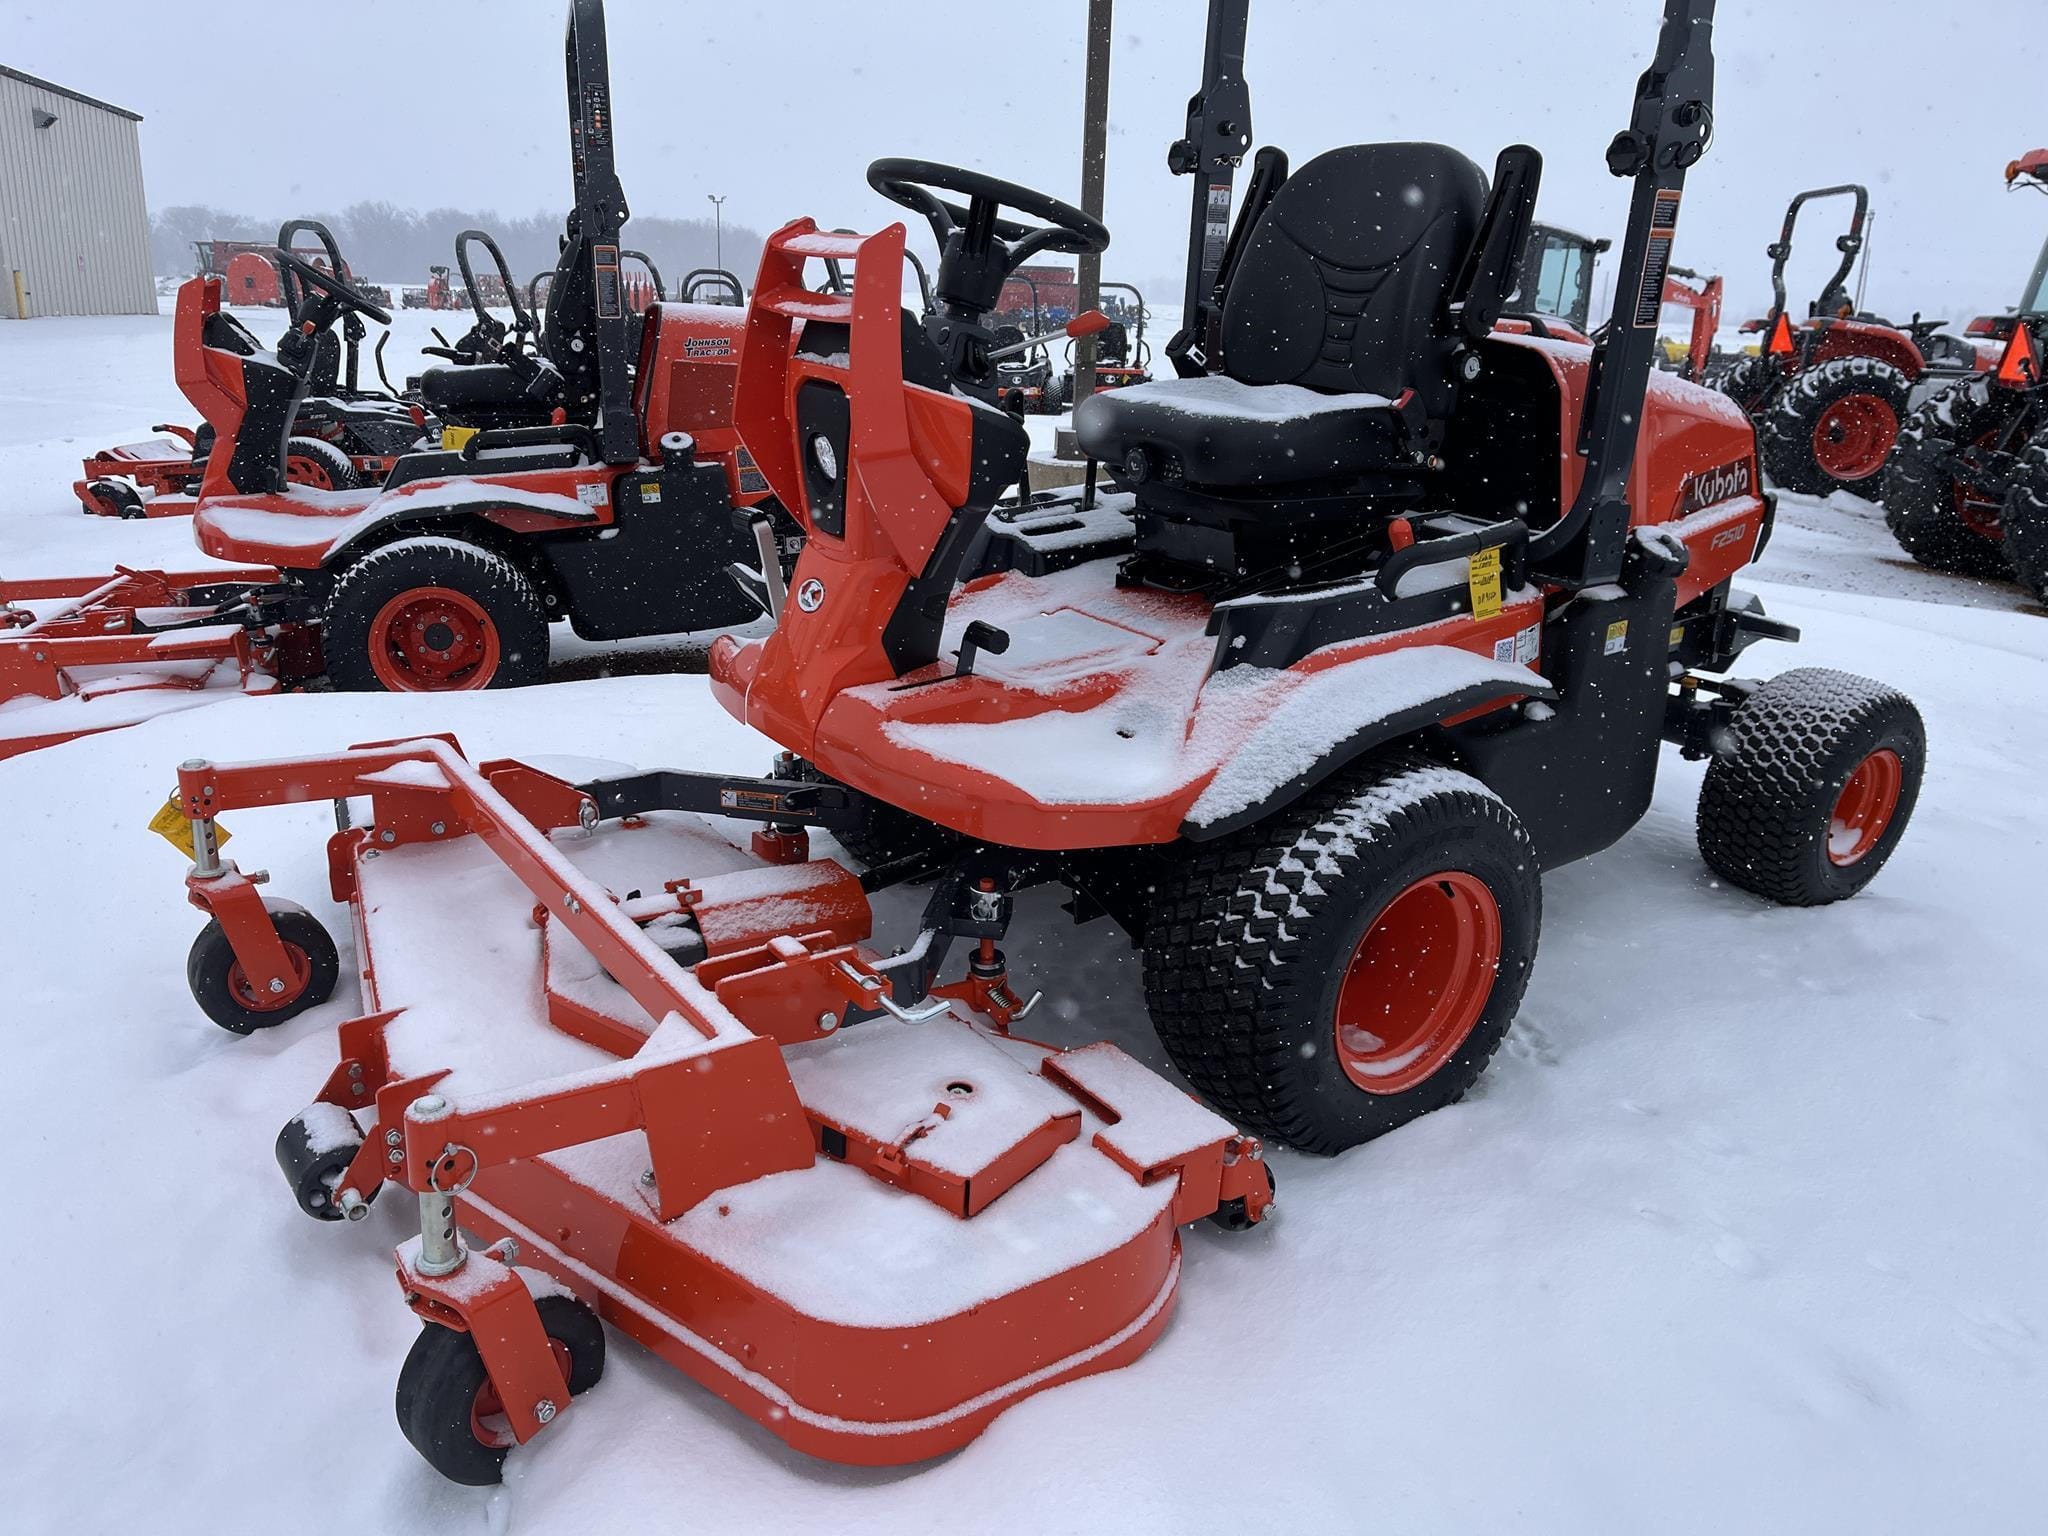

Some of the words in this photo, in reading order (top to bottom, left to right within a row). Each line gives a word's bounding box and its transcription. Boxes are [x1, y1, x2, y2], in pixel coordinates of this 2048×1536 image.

[684, 336, 730, 347] JOHNSON
[685, 346, 730, 356] TRACTOR
[1694, 462, 1748, 506] Kubota
[1710, 524, 1746, 551] F2510
